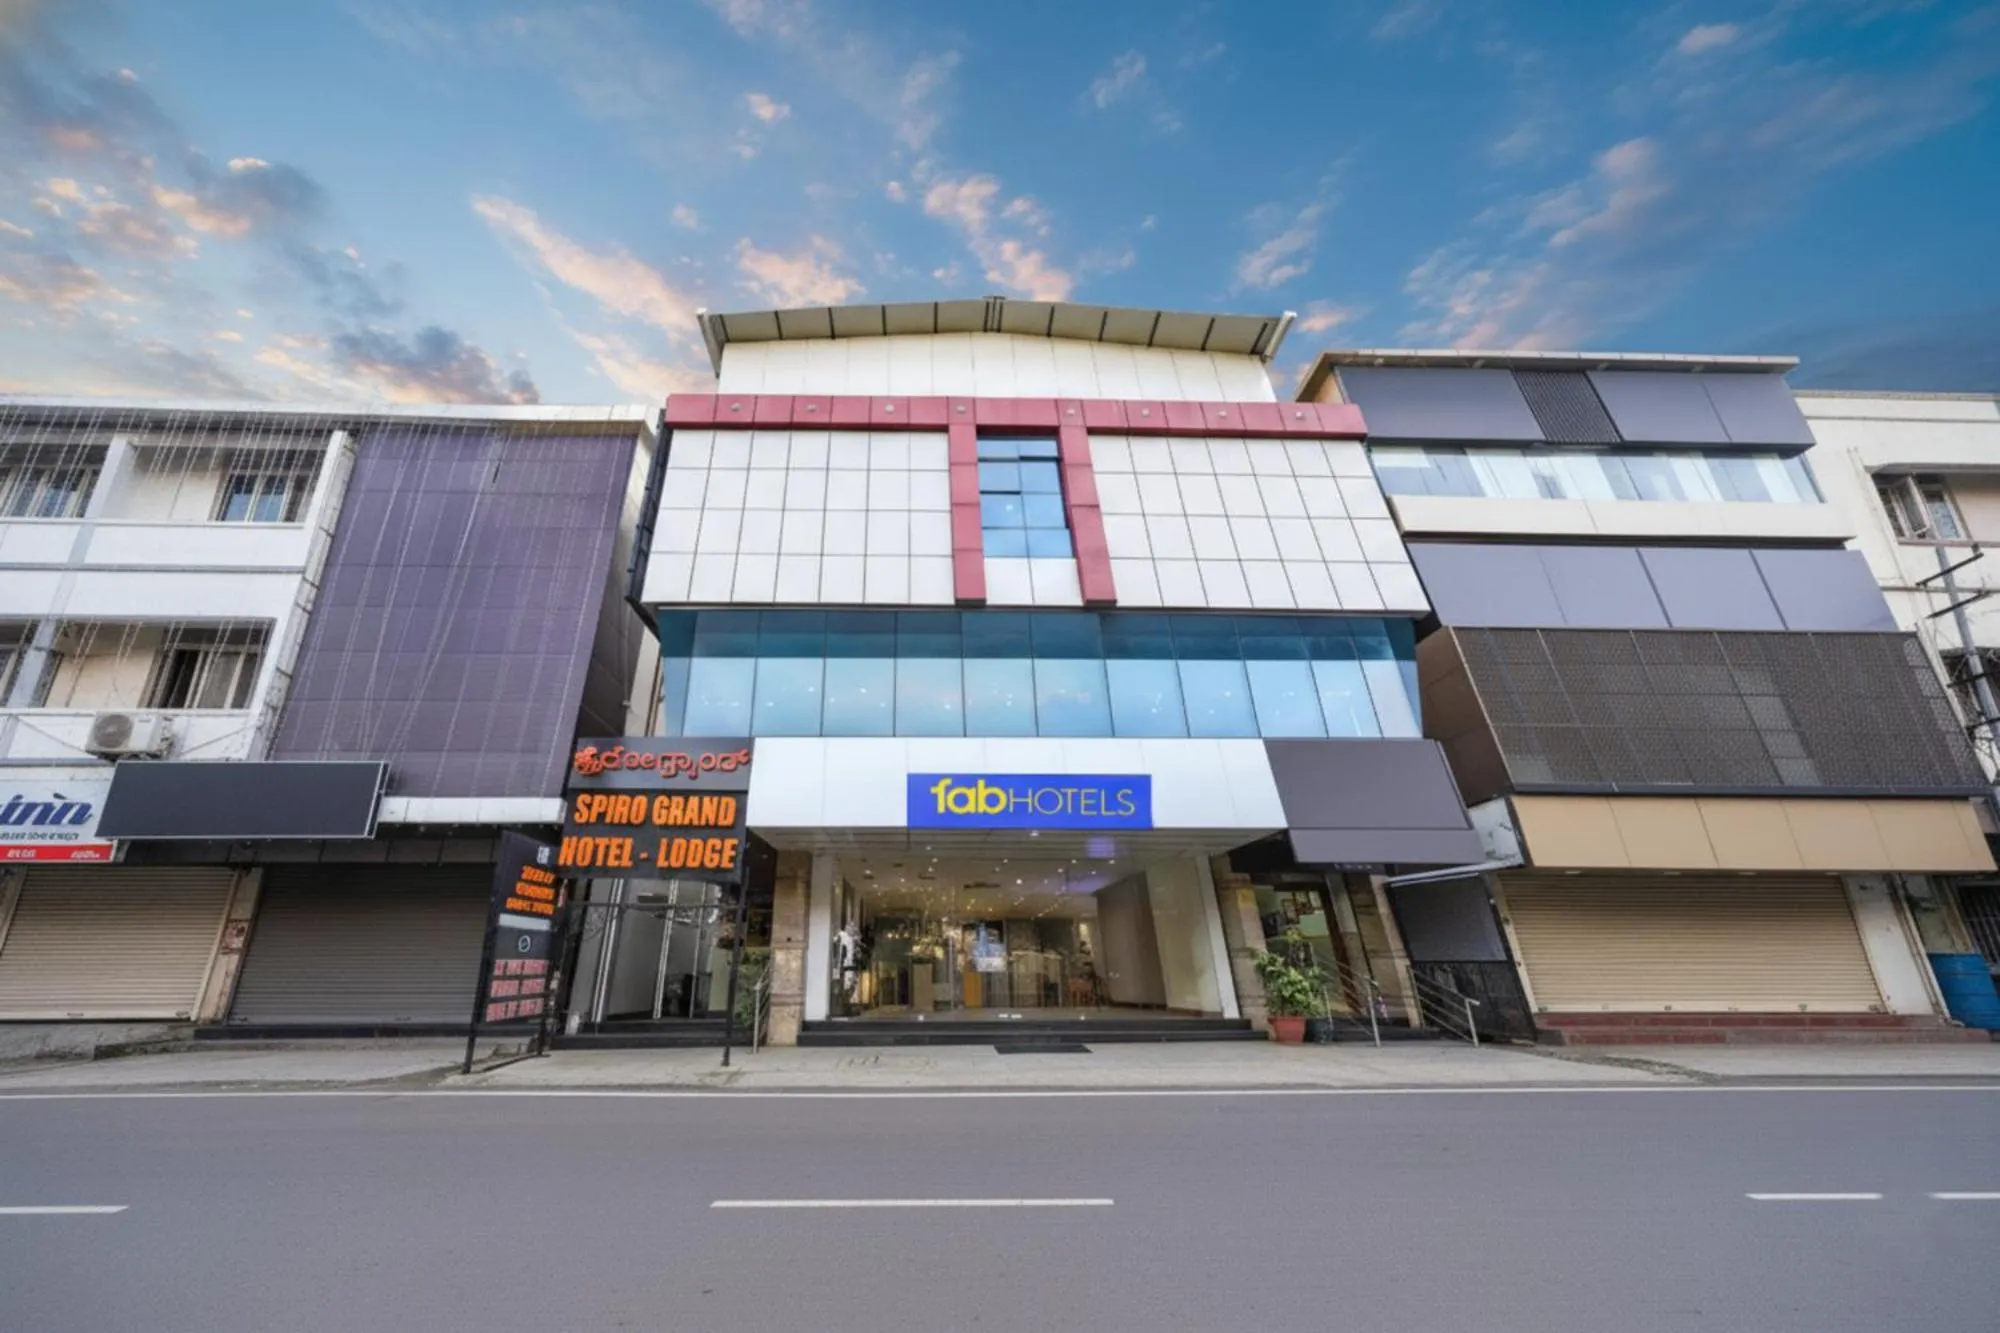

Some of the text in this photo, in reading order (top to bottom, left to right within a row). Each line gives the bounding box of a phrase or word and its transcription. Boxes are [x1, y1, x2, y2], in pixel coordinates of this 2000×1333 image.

[574, 793, 737, 827] SPIRO GRAND
[558, 836, 634, 868] HOTEL
[656, 837, 738, 869] LODGE
